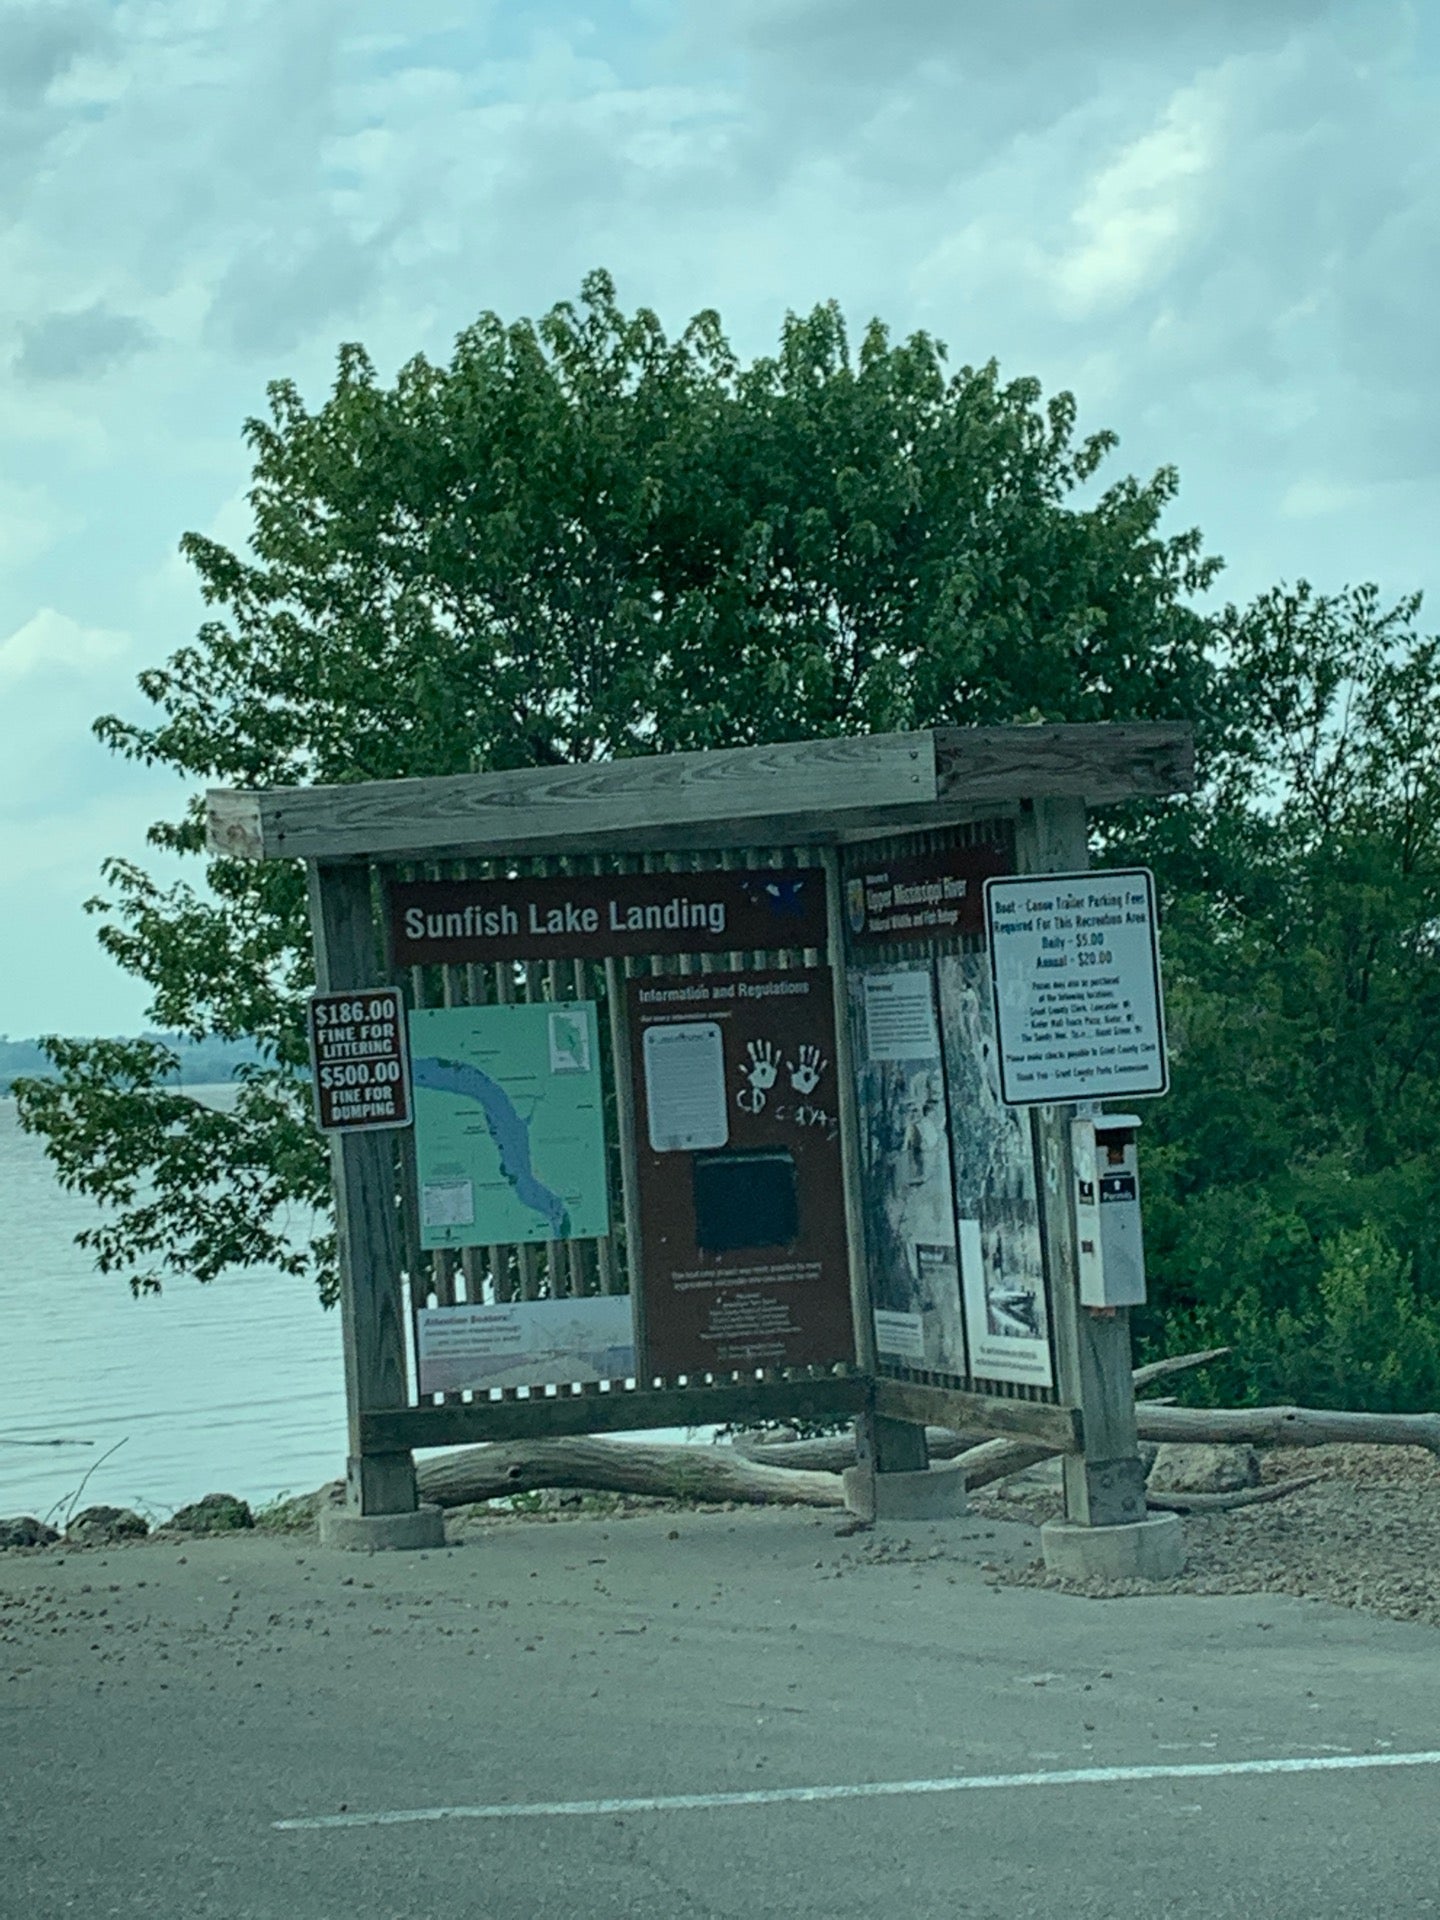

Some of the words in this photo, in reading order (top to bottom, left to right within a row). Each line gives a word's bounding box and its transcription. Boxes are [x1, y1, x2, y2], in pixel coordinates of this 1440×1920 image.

[1026, 898, 1053, 912] Canoe
[1056, 896, 1085, 910] Trailer
[1088, 894, 1122, 909] Parking
[405, 903, 520, 940] Sunfish
[528, 901, 600, 935] Lake
[609, 898, 727, 934] Landing
[994, 919, 1033, 935] Required
[1036, 917, 1052, 930] For
[1054, 915, 1073, 930] This
[1076, 912, 1123, 928] Recreation
[1125, 911, 1146, 924] Area
[1042, 936, 1065, 951] Daily
[1076, 932, 1104, 948] $5.00
[1036, 954, 1067, 969] Annual
[1078, 950, 1113, 967] $20.00
[639, 984, 710, 1003] Information
[713, 983, 736, 999] and
[738, 980, 810, 999] Regulations
[315, 999, 395, 1028] $186.00
[318, 1027, 356, 1044] FINE
[361, 1023, 395, 1040] FOR
[323, 1039, 393, 1059] LITTERING
[320, 1061, 400, 1090] $500.00
[331, 1089, 361, 1105] FINE
[364, 1085, 393, 1102] FOR
[332, 1102, 396, 1121] DUMPING
